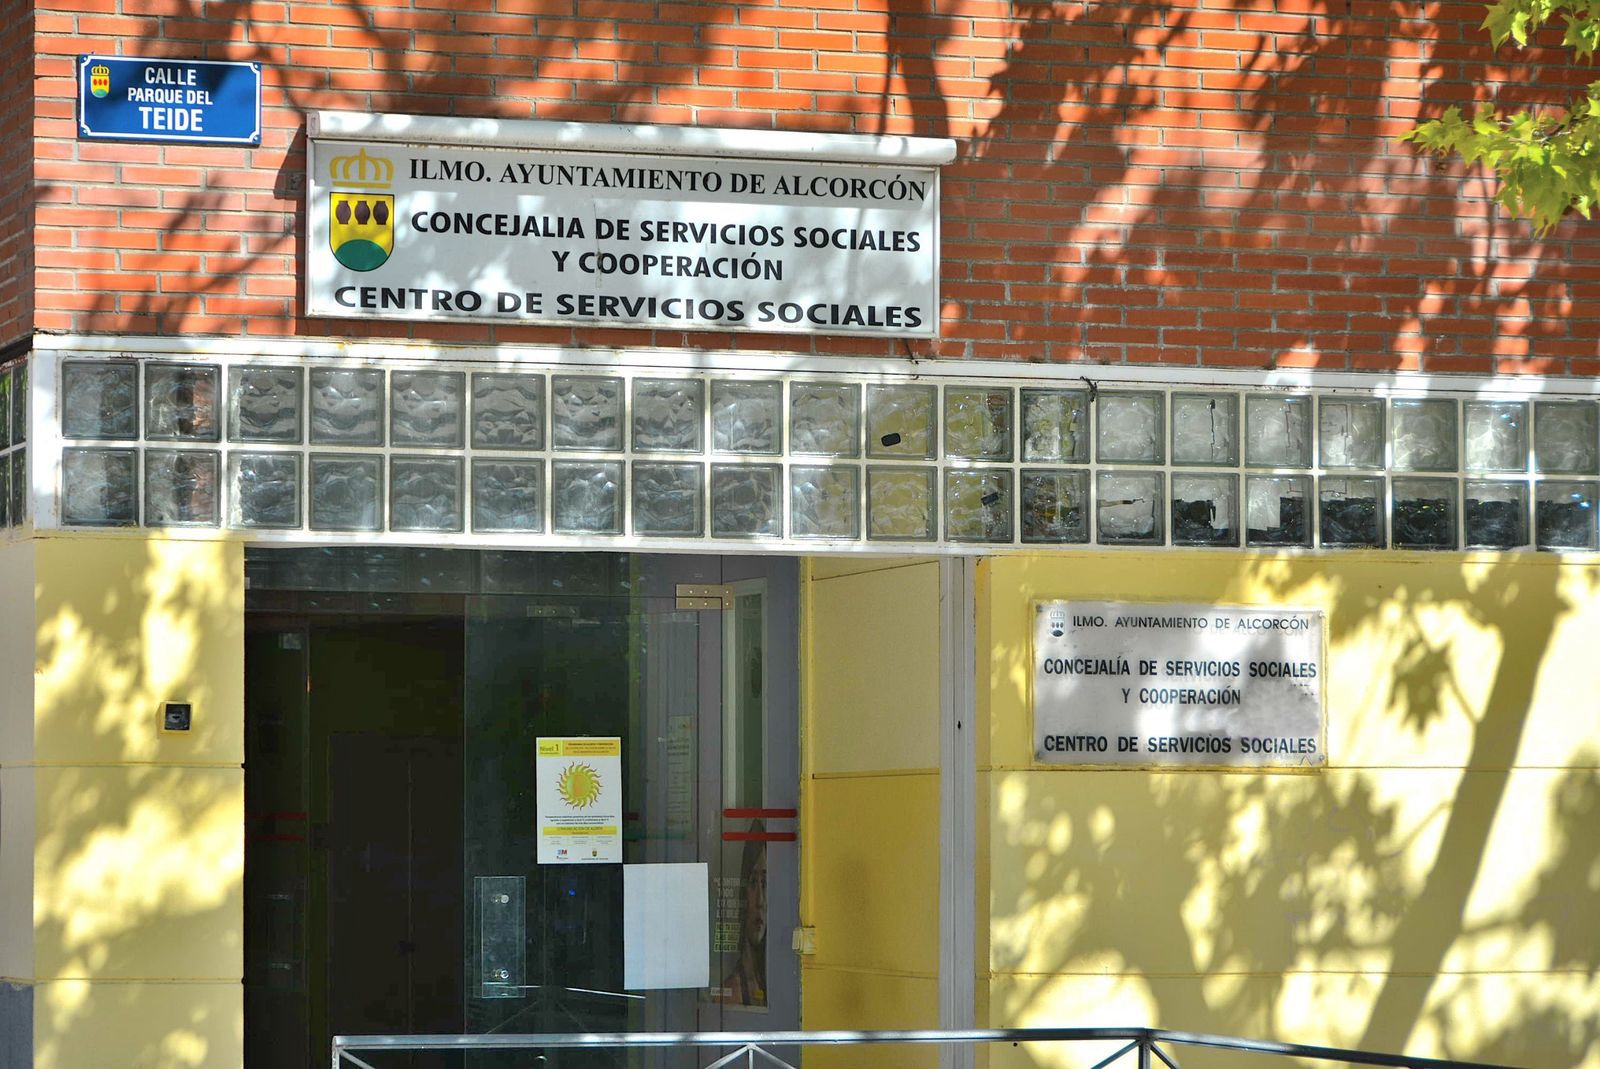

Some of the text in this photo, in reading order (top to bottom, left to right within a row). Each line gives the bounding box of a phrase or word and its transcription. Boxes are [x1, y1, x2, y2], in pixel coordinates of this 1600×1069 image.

[145, 67, 197, 86] CALLE
[127, 87, 213, 105] PARQUE DEL
[138, 106, 203, 131] TEIDE
[409, 158, 926, 201] ILMO. AYUNTAMIENTO DE ALCORCÓN
[411, 211, 921, 253] CONCEJALIA DE SERVICIOS SOCIALES
[551, 250, 783, 281] Y COOPERACIÓN
[334, 285, 922, 328] CENTRO DE SERVICIOS SOCIALES
[1072, 615, 1309, 631] ILMO. AYUNTAMIENTO DE ALCORCÓN
[1043, 655, 1317, 678] CONCEJALÍA DE SERVICIOS SOCIALES
[1121, 685, 1241, 705] Y COOPERACIÓN
[1043, 735, 1317, 754] CENTRO DE SERVICIOS SOCIALES
